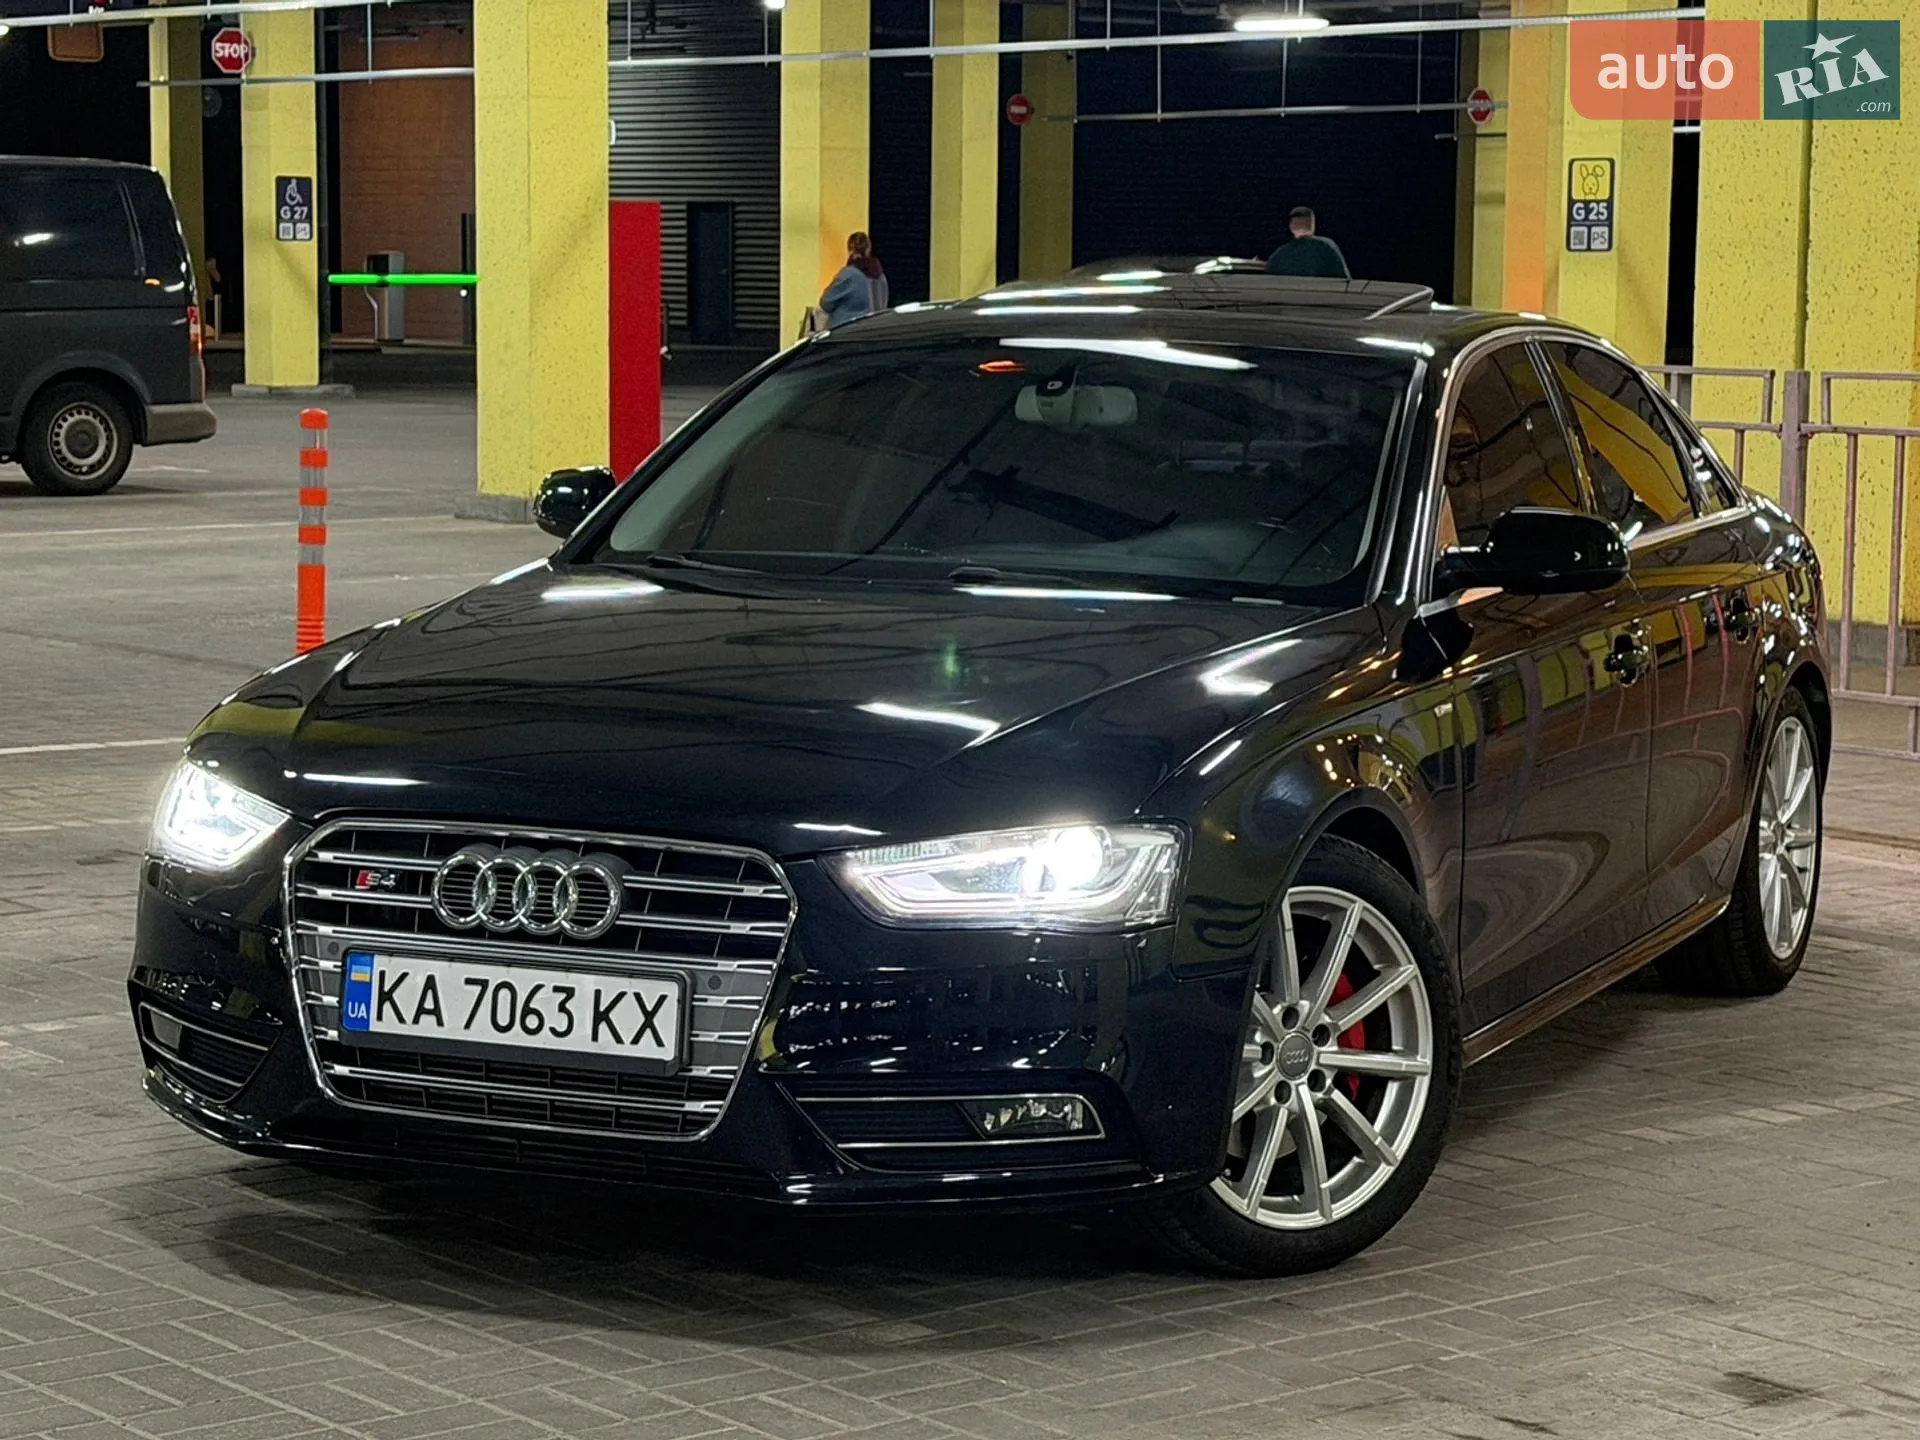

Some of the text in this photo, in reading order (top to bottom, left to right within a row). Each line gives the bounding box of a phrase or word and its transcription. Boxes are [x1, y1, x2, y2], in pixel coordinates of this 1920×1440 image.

[215, 43, 247, 58] STOP
[280, 206, 308, 219] G 27
[1572, 202, 1608, 220] G 25
[348, 1001, 368, 1020] UA
[376, 969, 669, 1048] KA 7063 KX
